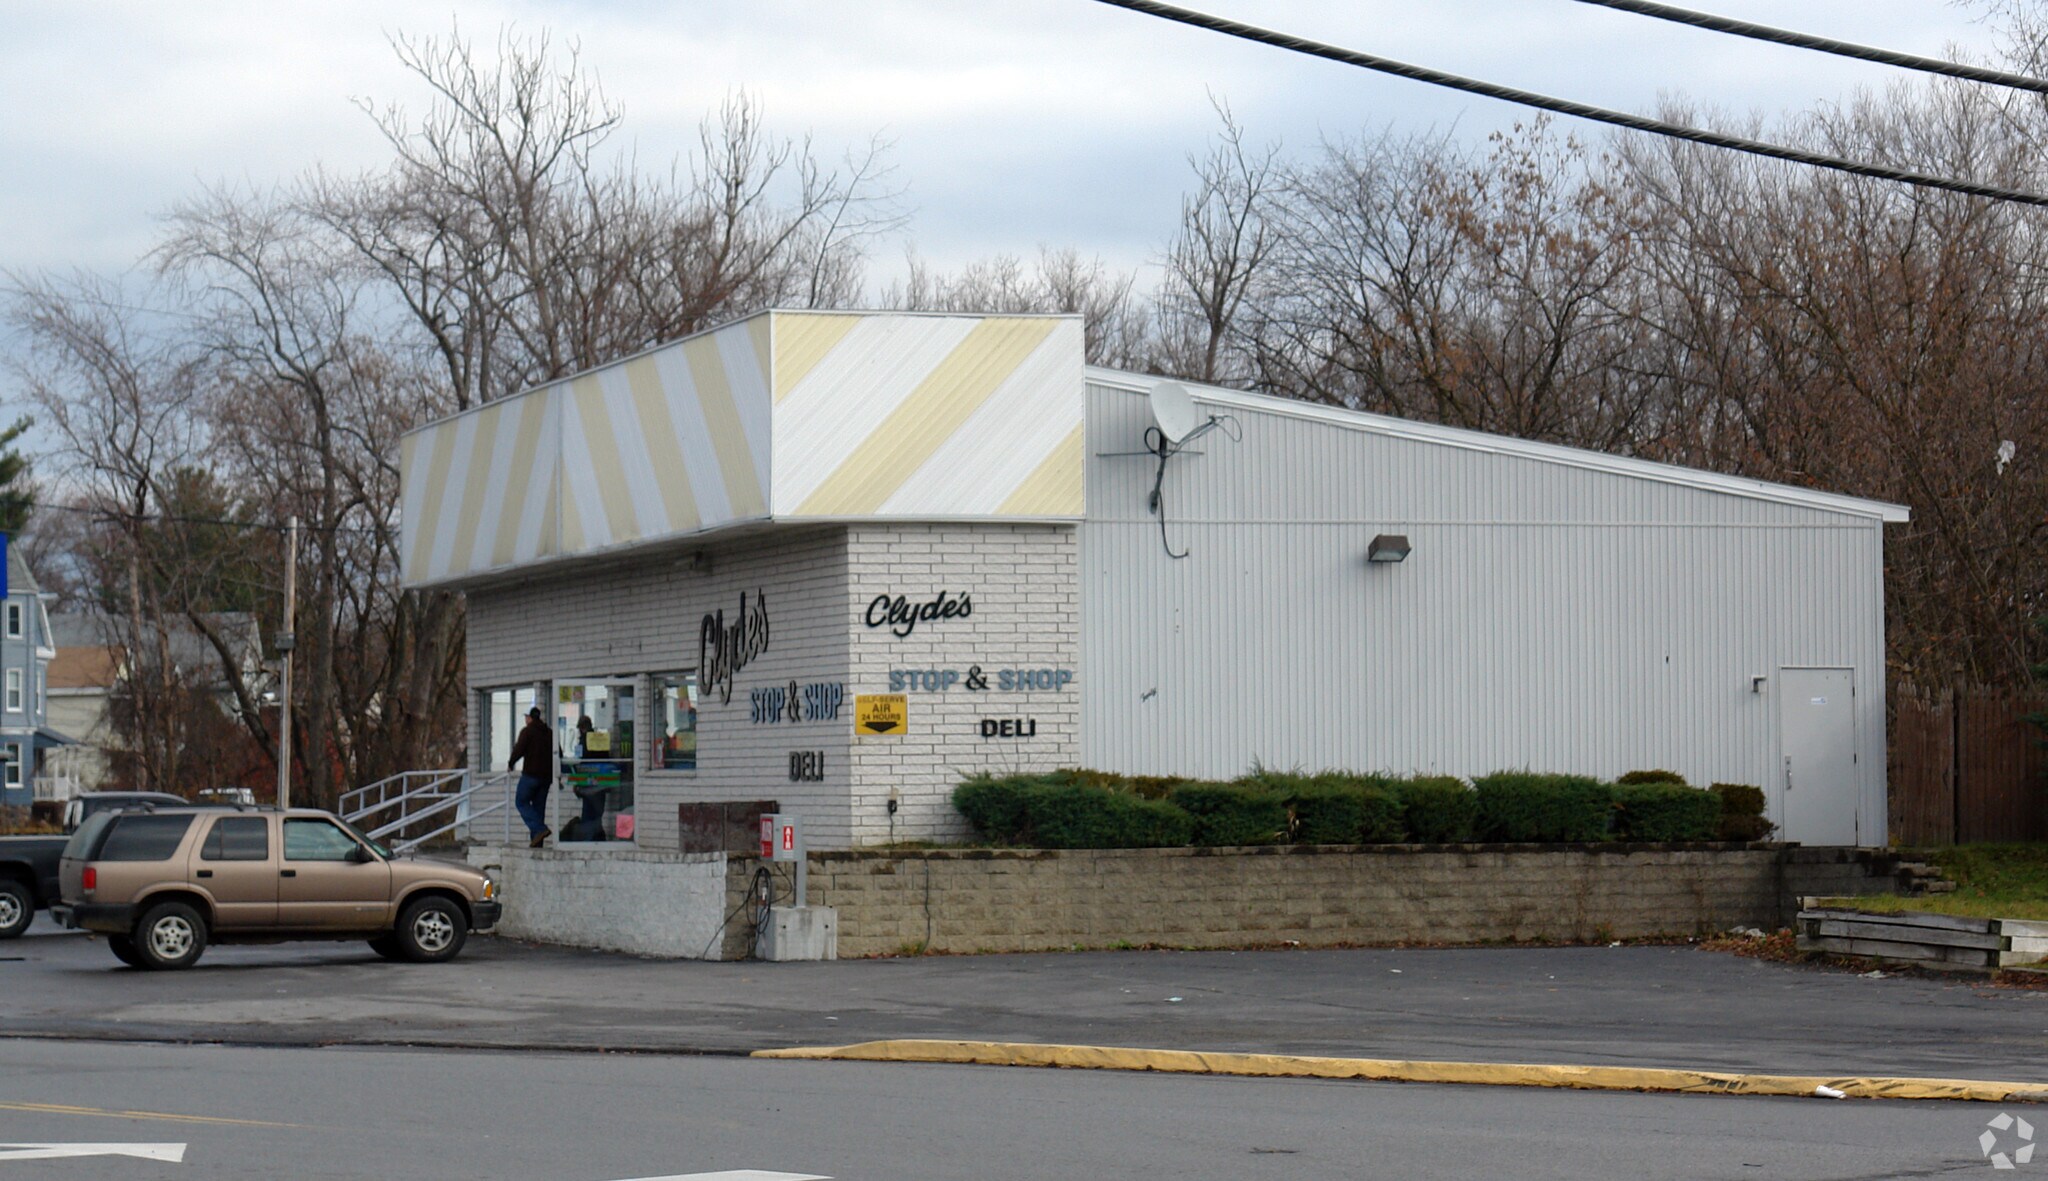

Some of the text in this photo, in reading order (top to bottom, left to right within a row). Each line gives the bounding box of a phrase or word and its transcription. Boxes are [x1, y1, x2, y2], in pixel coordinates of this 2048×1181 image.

[866, 591, 971, 637] Clyde's
[698, 588, 770, 705] Clyde's
[890, 666, 1073, 691] STOP & SHOP
[751, 680, 843, 723] STOP & SHOP
[872, 703, 891, 712] AIR
[981, 719, 1036, 737] DELI
[788, 751, 824, 781] DELI
